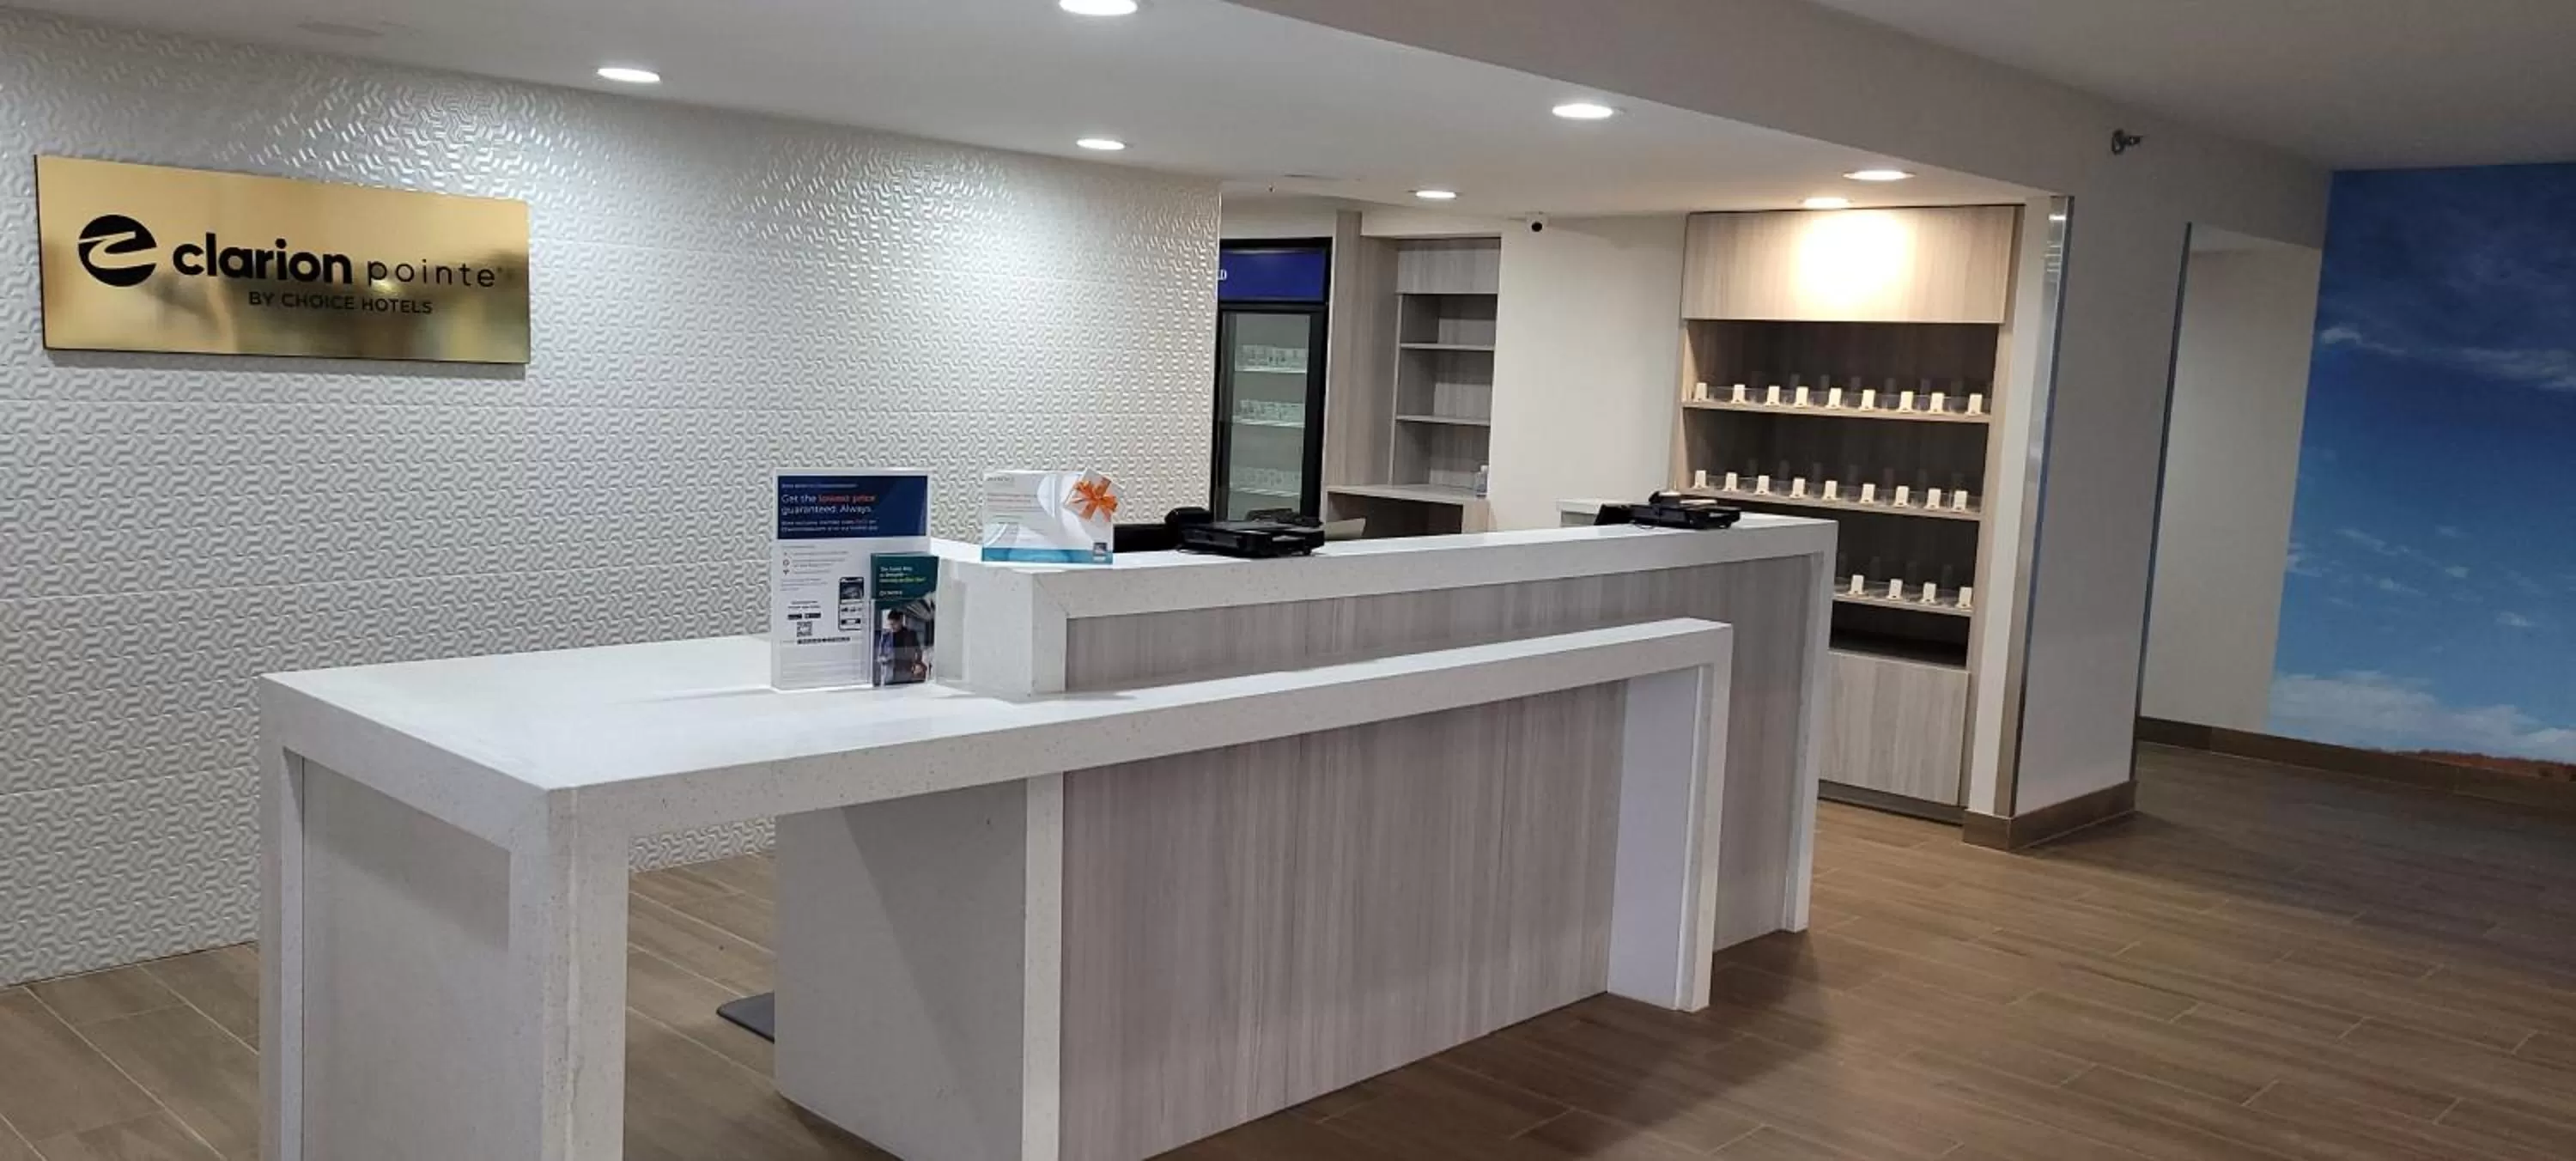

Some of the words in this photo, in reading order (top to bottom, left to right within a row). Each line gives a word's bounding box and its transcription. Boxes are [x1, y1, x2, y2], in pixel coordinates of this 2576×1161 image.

[173, 232, 352, 284] clarion
[368, 258, 496, 287] pointe
[248, 291, 275, 306] BY
[281, 293, 355, 310] CHOICE
[361, 297, 433, 313] HOTELS
[781, 494, 798, 503] Get
[800, 494, 817, 503] the
